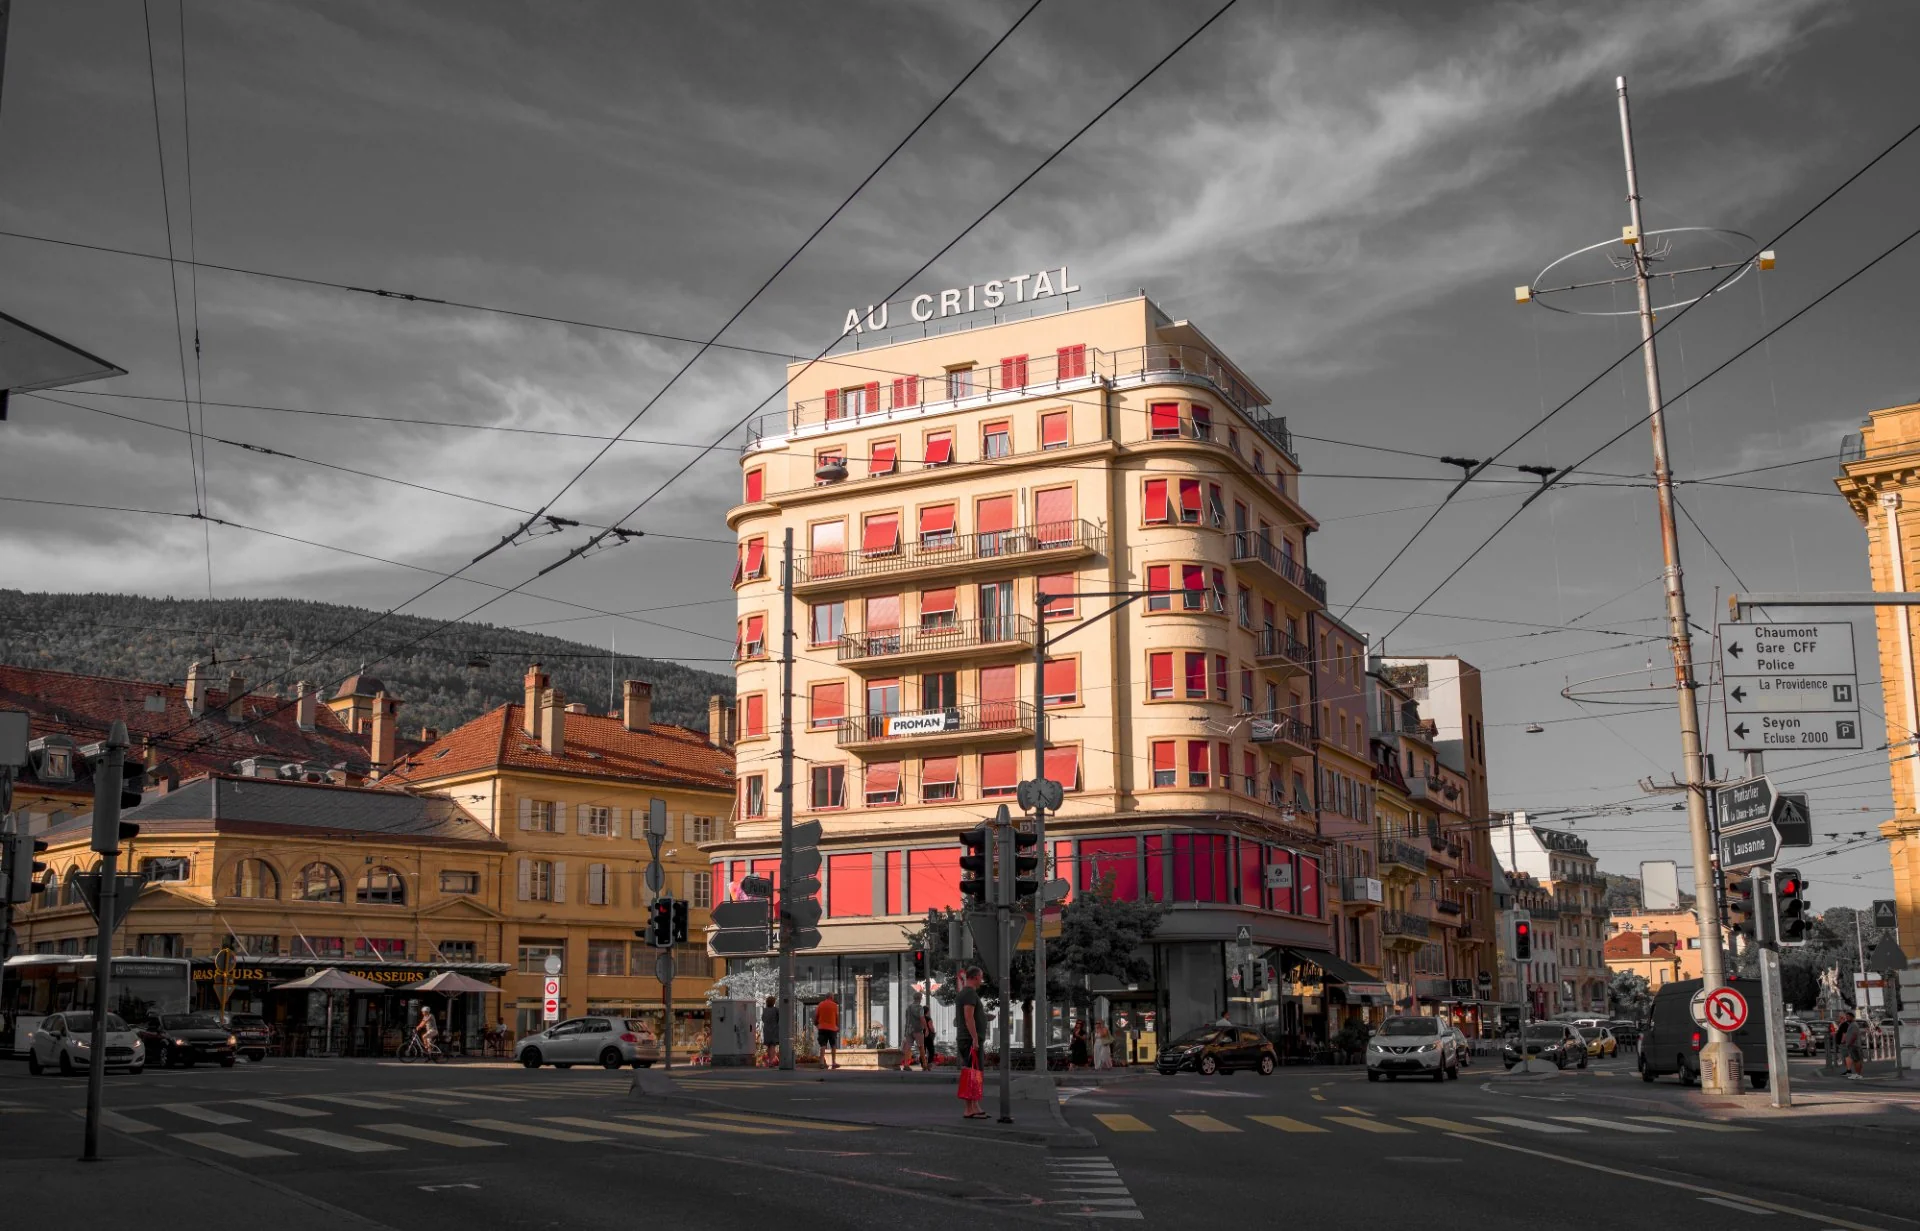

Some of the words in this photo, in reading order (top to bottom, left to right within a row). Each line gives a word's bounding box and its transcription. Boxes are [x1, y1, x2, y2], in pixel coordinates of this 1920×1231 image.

[843, 302, 889, 336] AU
[910, 266, 1081, 323] CRISTAL
[1755, 626, 1818, 638] Chaumont
[1756, 642, 1785, 653] Gare
[1793, 641, 1817, 653] CFF
[1757, 659, 1795, 671] Police
[1759, 679, 1770, 690] La
[1776, 678, 1828, 690] Providence
[893, 717, 940, 730] PROMAN
[1763, 717, 1801, 730] Seyon
[1763, 732, 1796, 744] Ecluse
[1801, 731, 1829, 744] 2000
[1733, 839, 1766, 856] Lausanne
